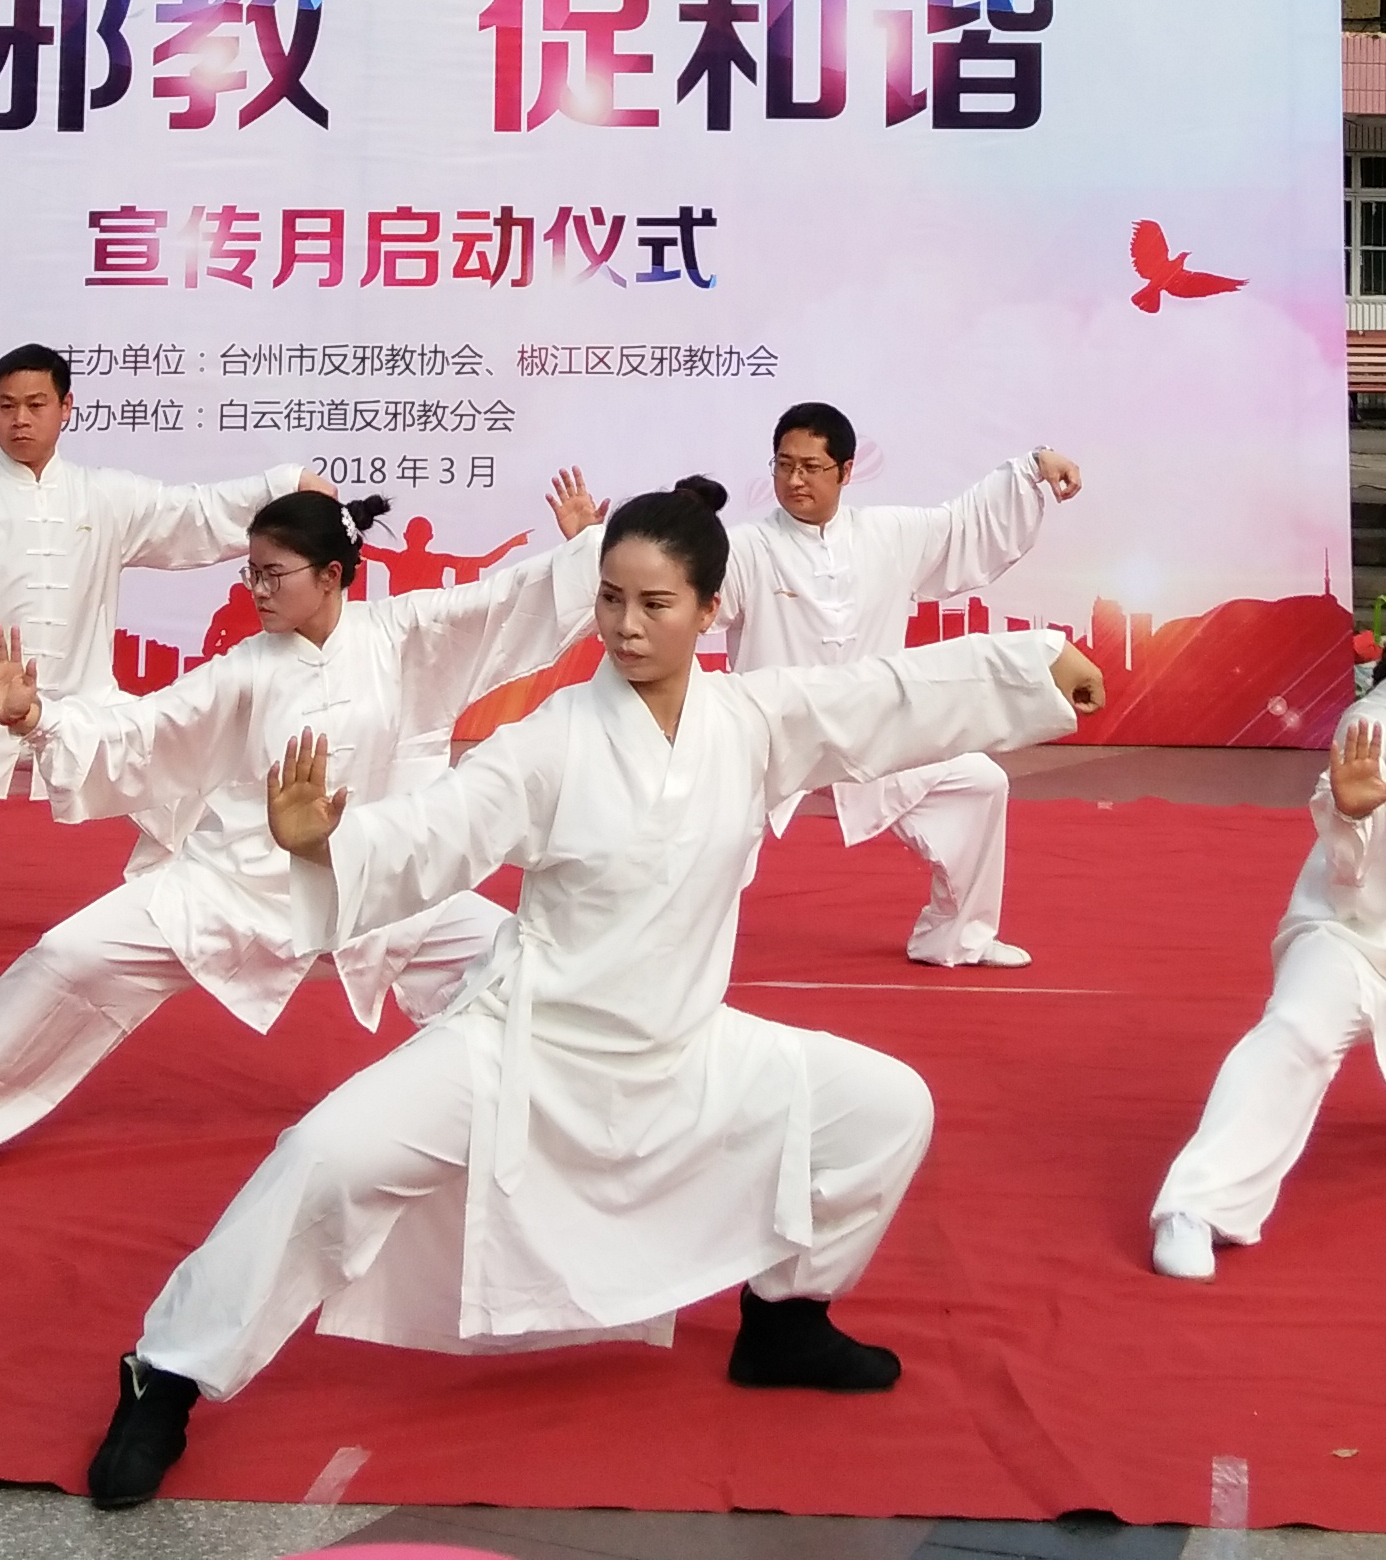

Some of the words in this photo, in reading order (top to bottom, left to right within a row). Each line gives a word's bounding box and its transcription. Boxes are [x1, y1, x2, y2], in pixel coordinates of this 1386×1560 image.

[84, 206, 718, 290] 宣传月启动仪式
